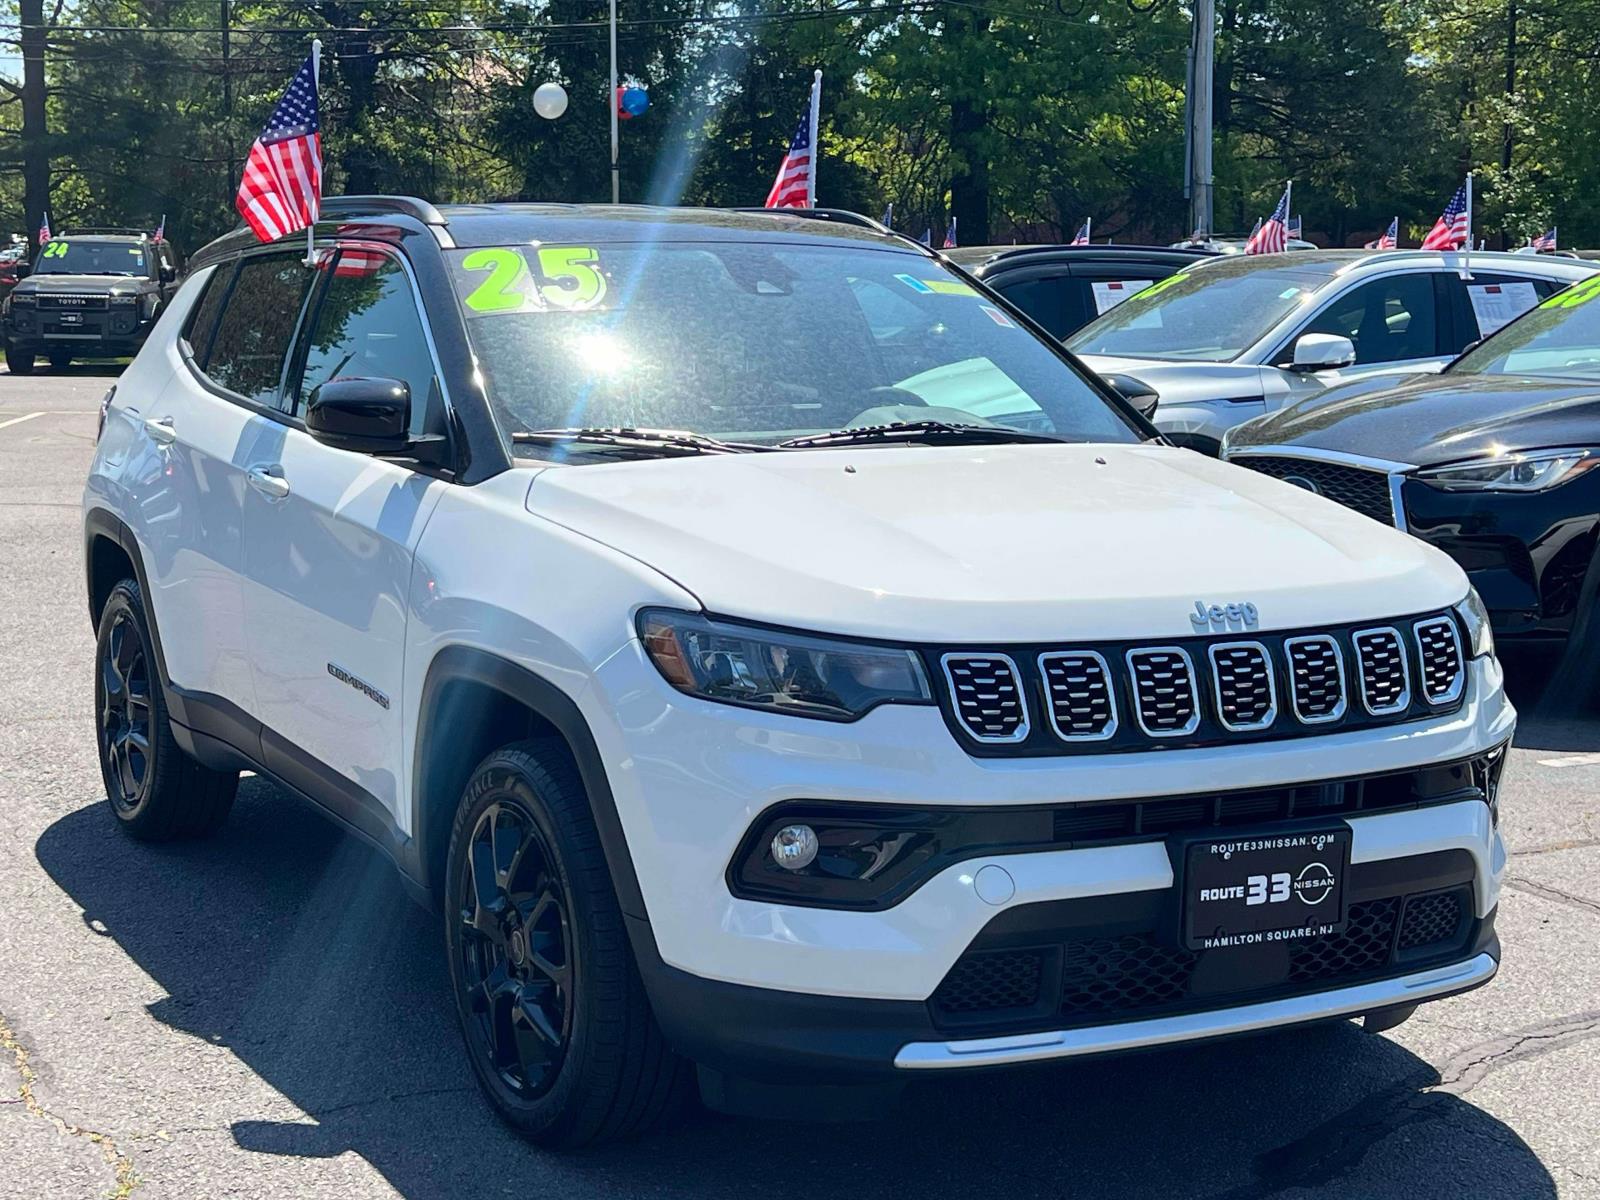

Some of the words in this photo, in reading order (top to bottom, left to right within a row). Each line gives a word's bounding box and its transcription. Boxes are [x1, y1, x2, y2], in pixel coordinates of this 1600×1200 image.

[43, 242, 69, 258] 24
[462, 247, 607, 313] 25
[1189, 600, 1258, 629] Jeep
[327, 662, 390, 710] COMPASS
[1210, 834, 1335, 854] ROUTE33NISSAN.COM
[1200, 886, 1244, 901] ROUTE
[1246, 872, 1291, 906] 33
[1293, 877, 1335, 889] NISSAN
[1204, 933, 1262, 948] HAMILTON
[1266, 927, 1316, 941] SQUARE,
[1319, 925, 1333, 934] NJ
